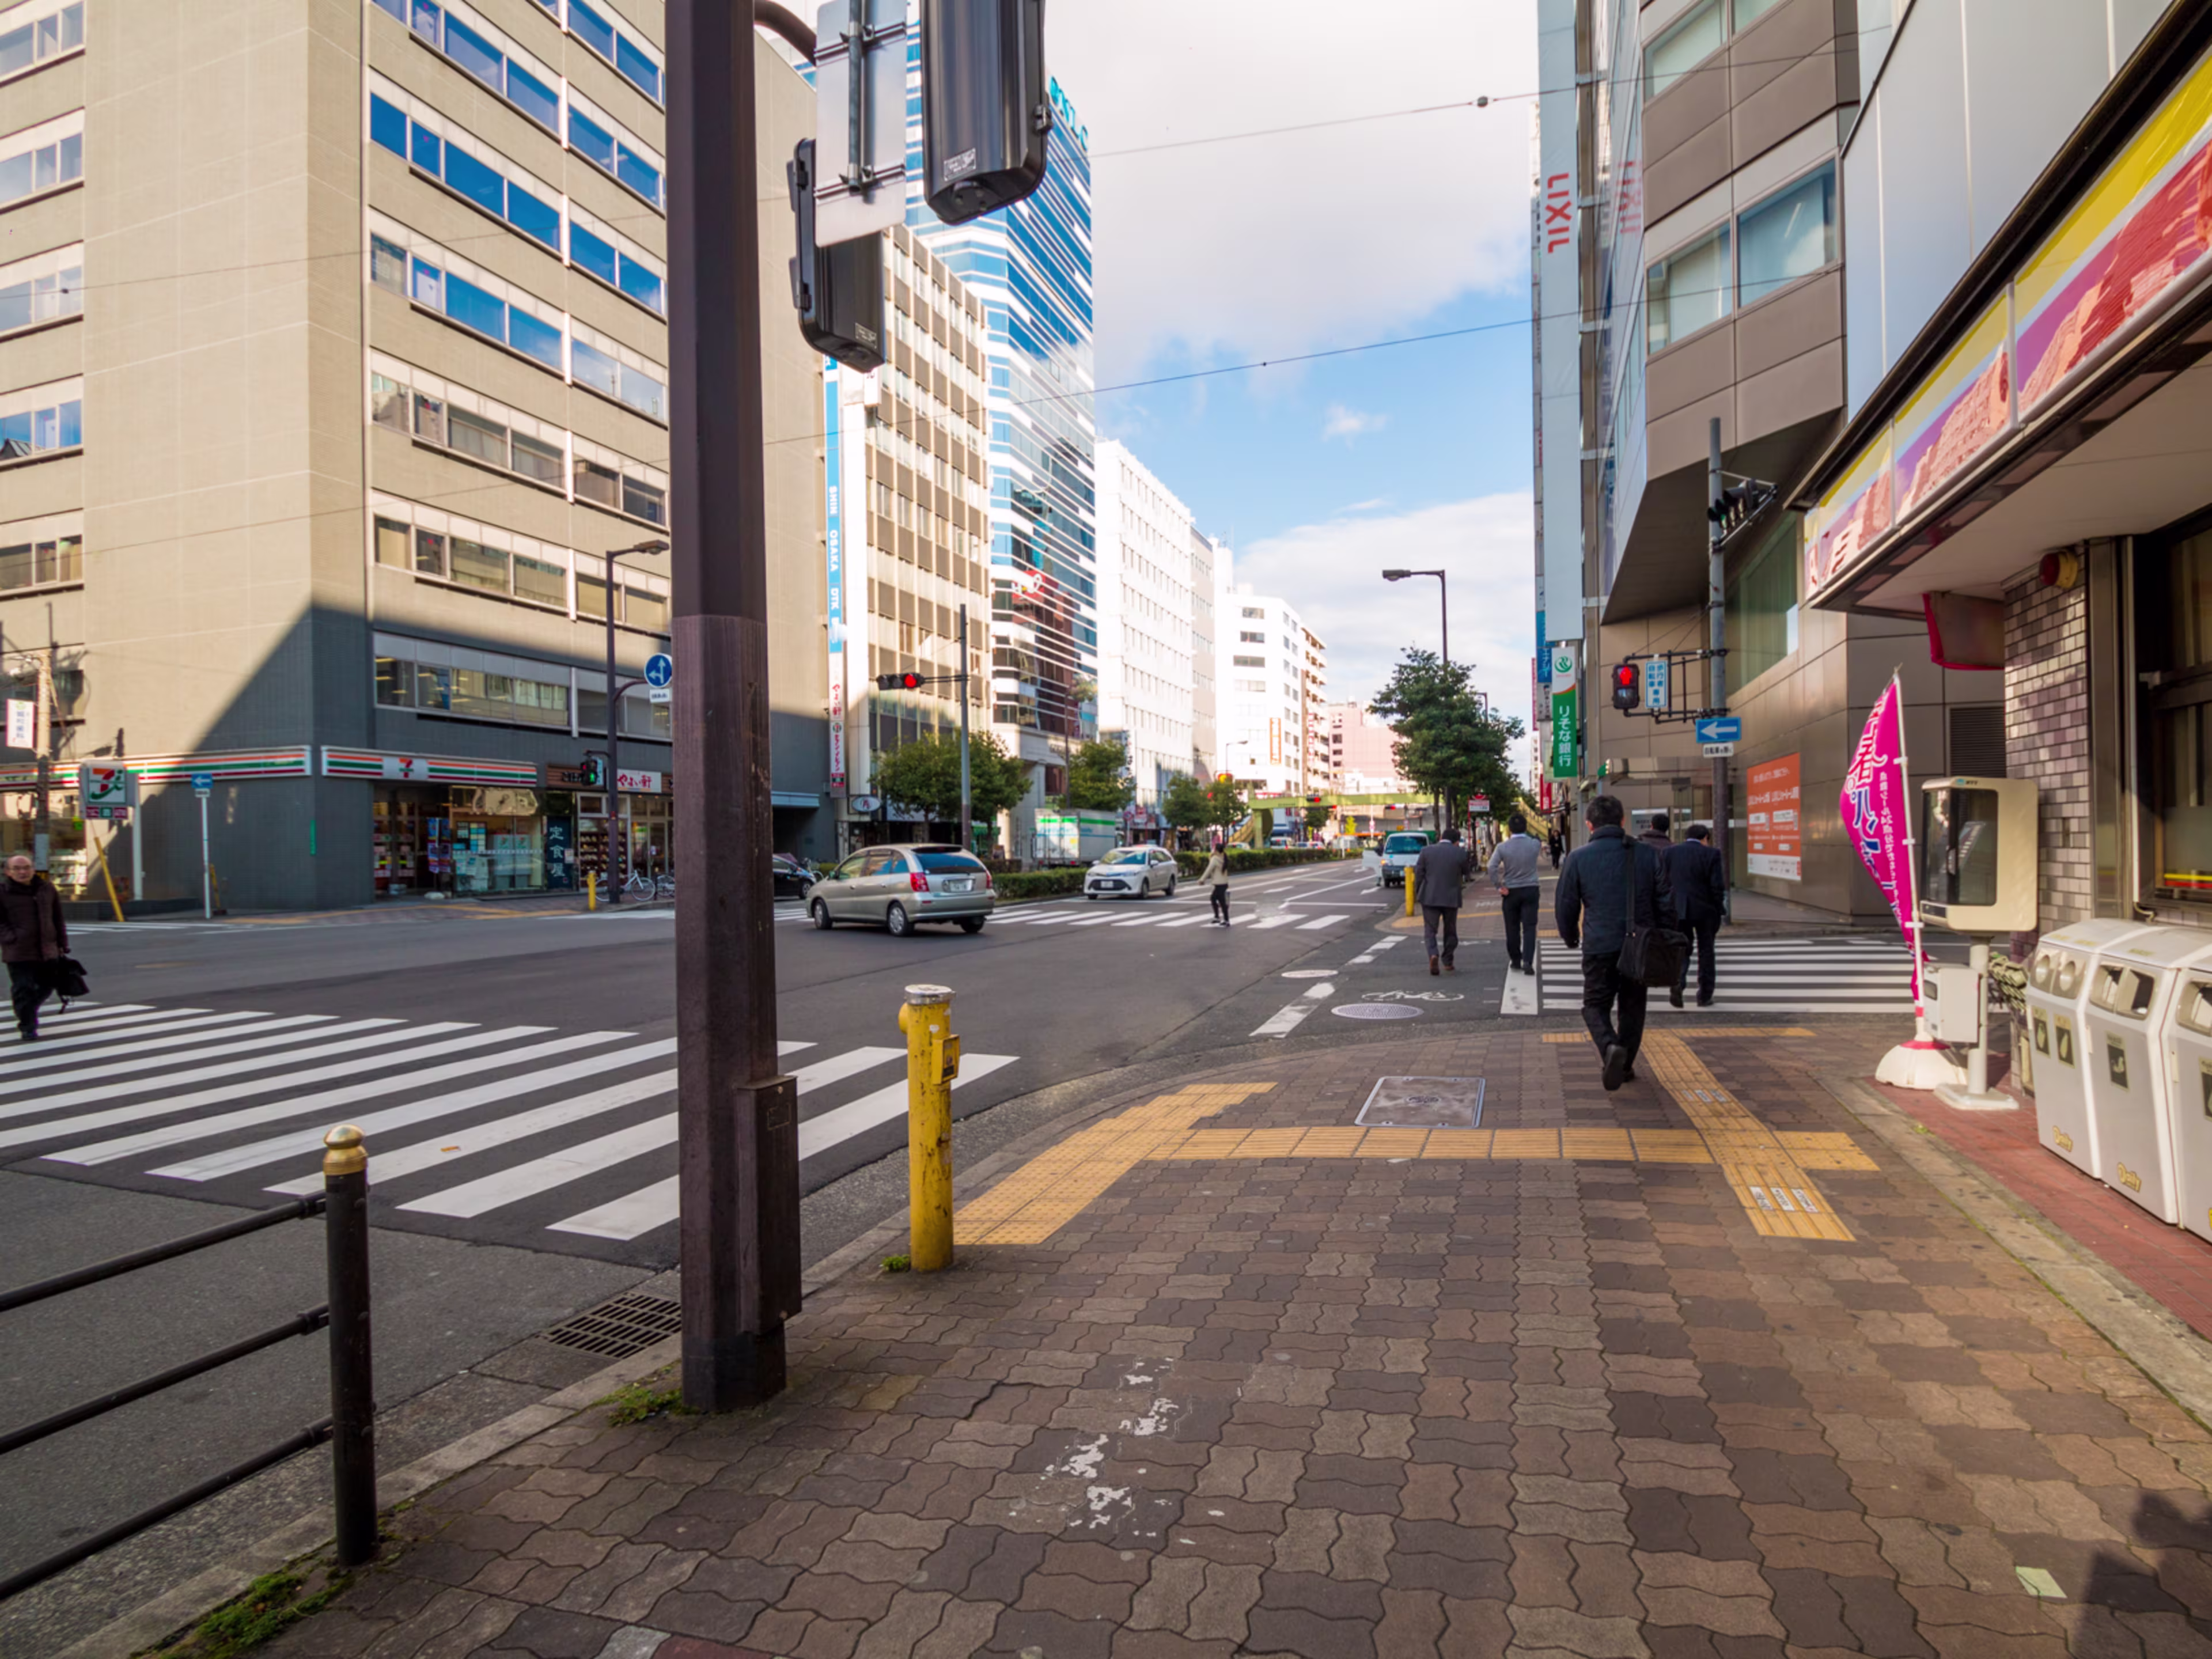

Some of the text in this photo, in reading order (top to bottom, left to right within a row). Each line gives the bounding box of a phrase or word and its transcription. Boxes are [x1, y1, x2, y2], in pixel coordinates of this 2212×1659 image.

[1545, 172, 1572, 253] LIXIL
[829, 486, 838, 514] SHIN
[830, 530, 838, 572] OSAKA
[1558, 705, 1571, 767] りそな銀行
[549, 825, 565, 877] 定食屋
[2052, 1126, 2073, 1153] Daily
[2116, 1161, 2142, 1193] Daily
